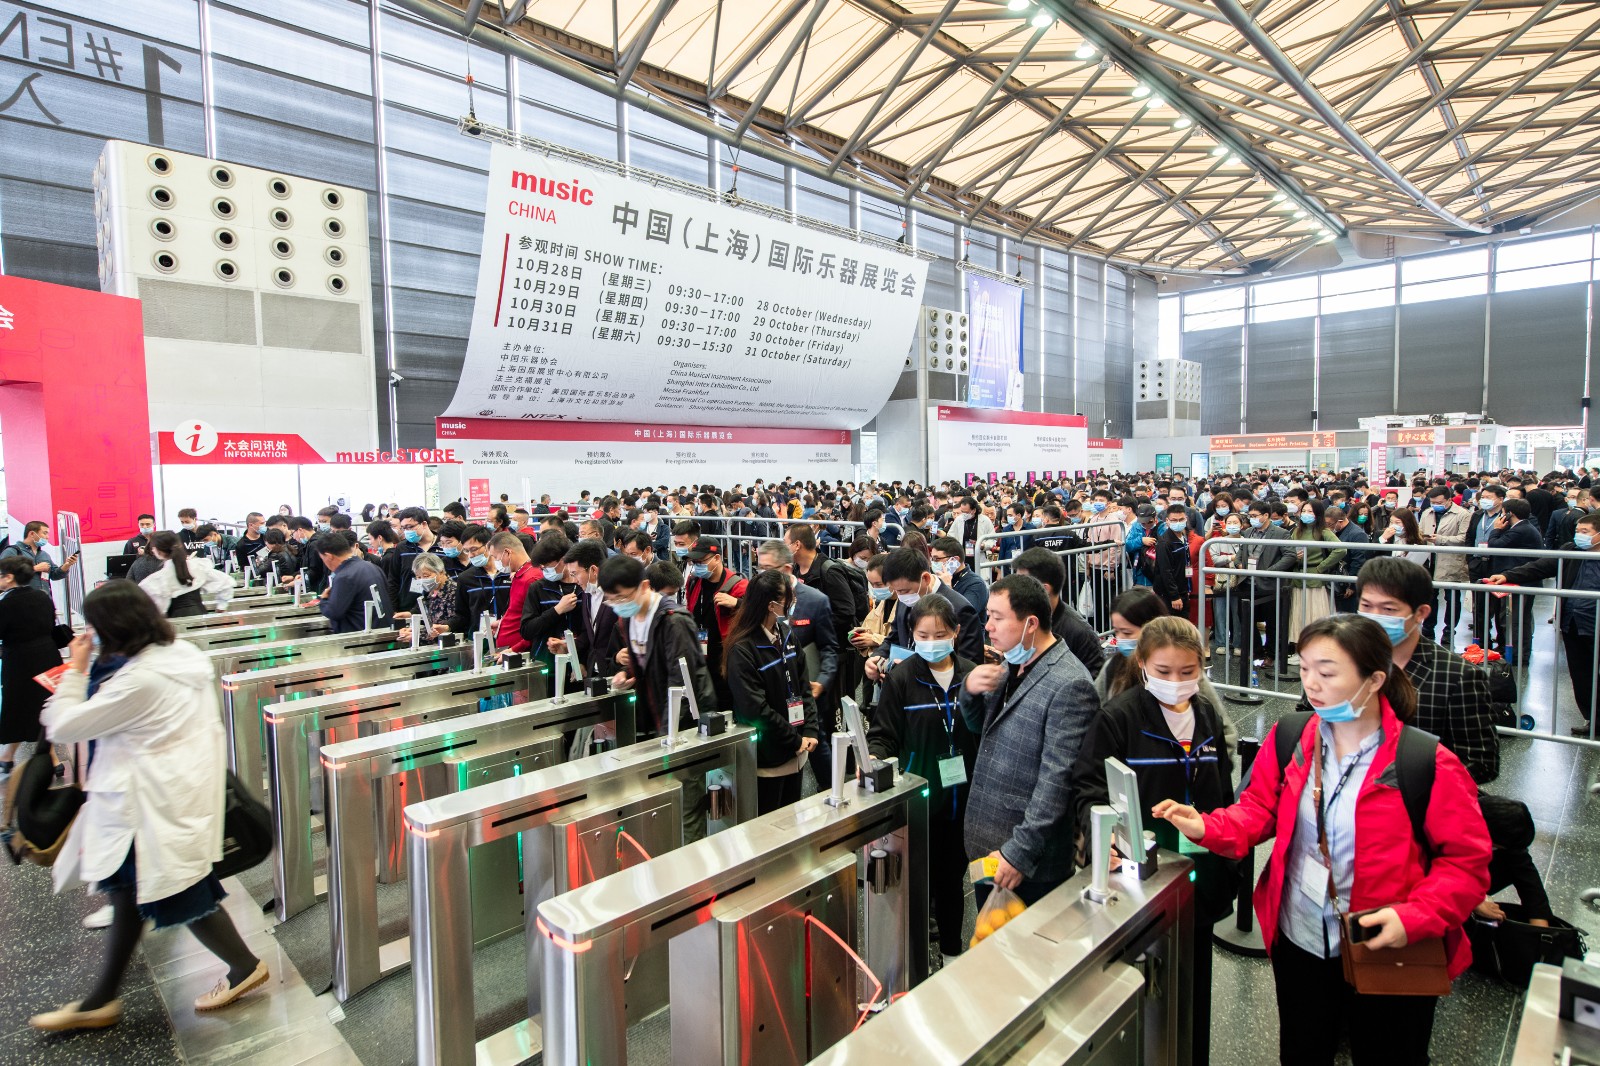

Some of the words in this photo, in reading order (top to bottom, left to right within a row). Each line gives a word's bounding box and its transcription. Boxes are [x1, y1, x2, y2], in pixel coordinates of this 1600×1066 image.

[511, 170, 594, 206] music
[508, 200, 556, 224] CHINA
[518, 236, 578, 260] 参观时间
[584, 250, 624, 268] SHOW
[612, 201, 917, 298] 中国（上海）国际乐器展览会
[516, 257, 582, 280] 10月28日
[602, 272, 652, 294] （星期三）
[757, 300, 769, 311] 28
[773, 304, 812, 319] October
[815, 310, 872, 330] (Wednesday)
[513, 277, 580, 300] 10月29日
[599, 290, 648, 310] （星期四）
[753, 316, 765, 327] 29
[769, 319, 808, 334] October
[812, 325, 860, 342] (Thursday)
[511, 297, 576, 318] 10月30日
[596, 308, 645, 328] （星期五）
[750, 331, 762, 342] 30
[765, 334, 804, 349] October
[807, 339, 844, 354] (Friday)
[508, 316, 573, 335] 10月31日
[592, 326, 641, 344] （星期六）
[745, 347, 757, 357] 31
[761, 348, 800, 362] October
[803, 354, 852, 369] (Saturday)
[500, 354, 558, 366] 中国乐器协会
[667, 378, 695, 387] Shanghai
[688, 371, 710, 379] Musical
[442, 422, 466, 430] music
[224, 440, 287, 450] 大会问讯处
[336, 449, 392, 463] music
[397, 448, 455, 463] STORE
